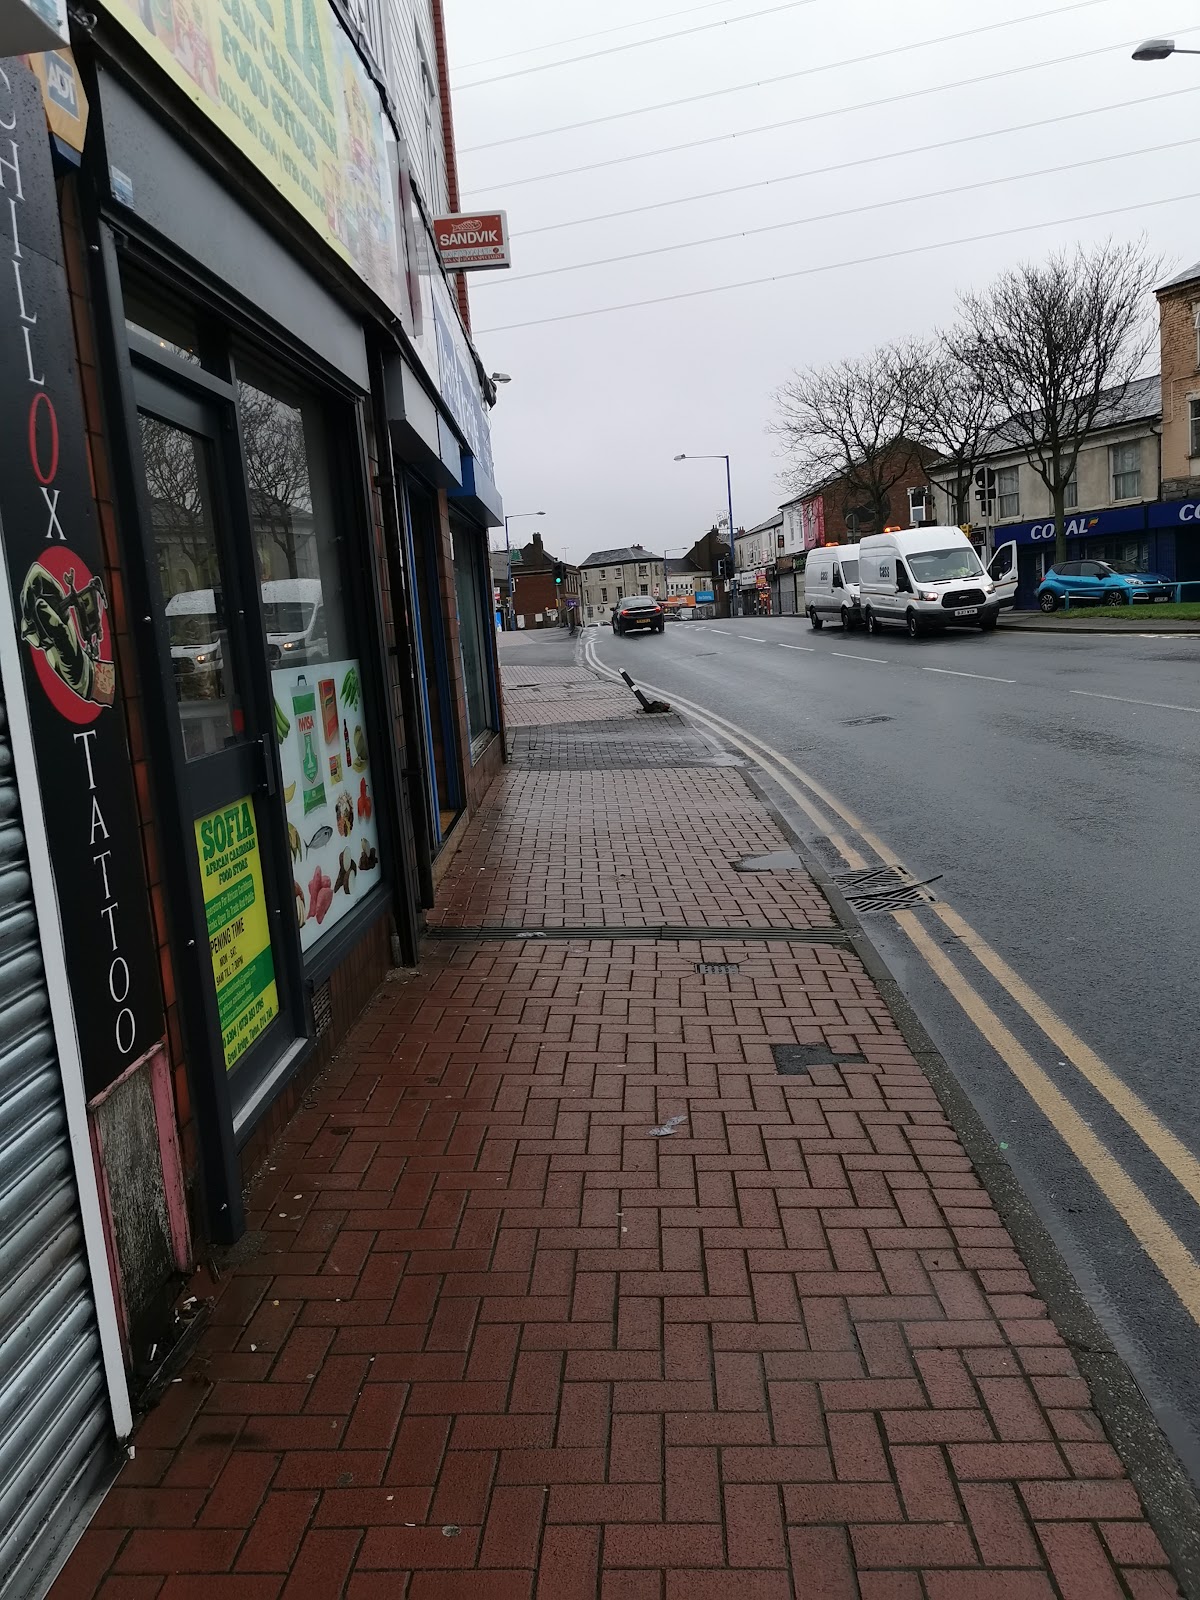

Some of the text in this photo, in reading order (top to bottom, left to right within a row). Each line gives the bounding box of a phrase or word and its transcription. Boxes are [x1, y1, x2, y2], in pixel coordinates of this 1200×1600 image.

[47, 61, 75, 105] ADT
[219, 18, 268, 109] FOOD
[270, 84, 318, 172] STORE
[440, 230, 498, 246] SANDVIK
[1030, 518, 1088, 540] COAL
[201, 802, 254, 861] SOFIA
[206, 853, 229, 877] AFRICAN
[218, 857, 248, 885] FOOD STORE
[73, 729, 135, 1053] TATTOO
[231, 917, 244, 939] TIME
